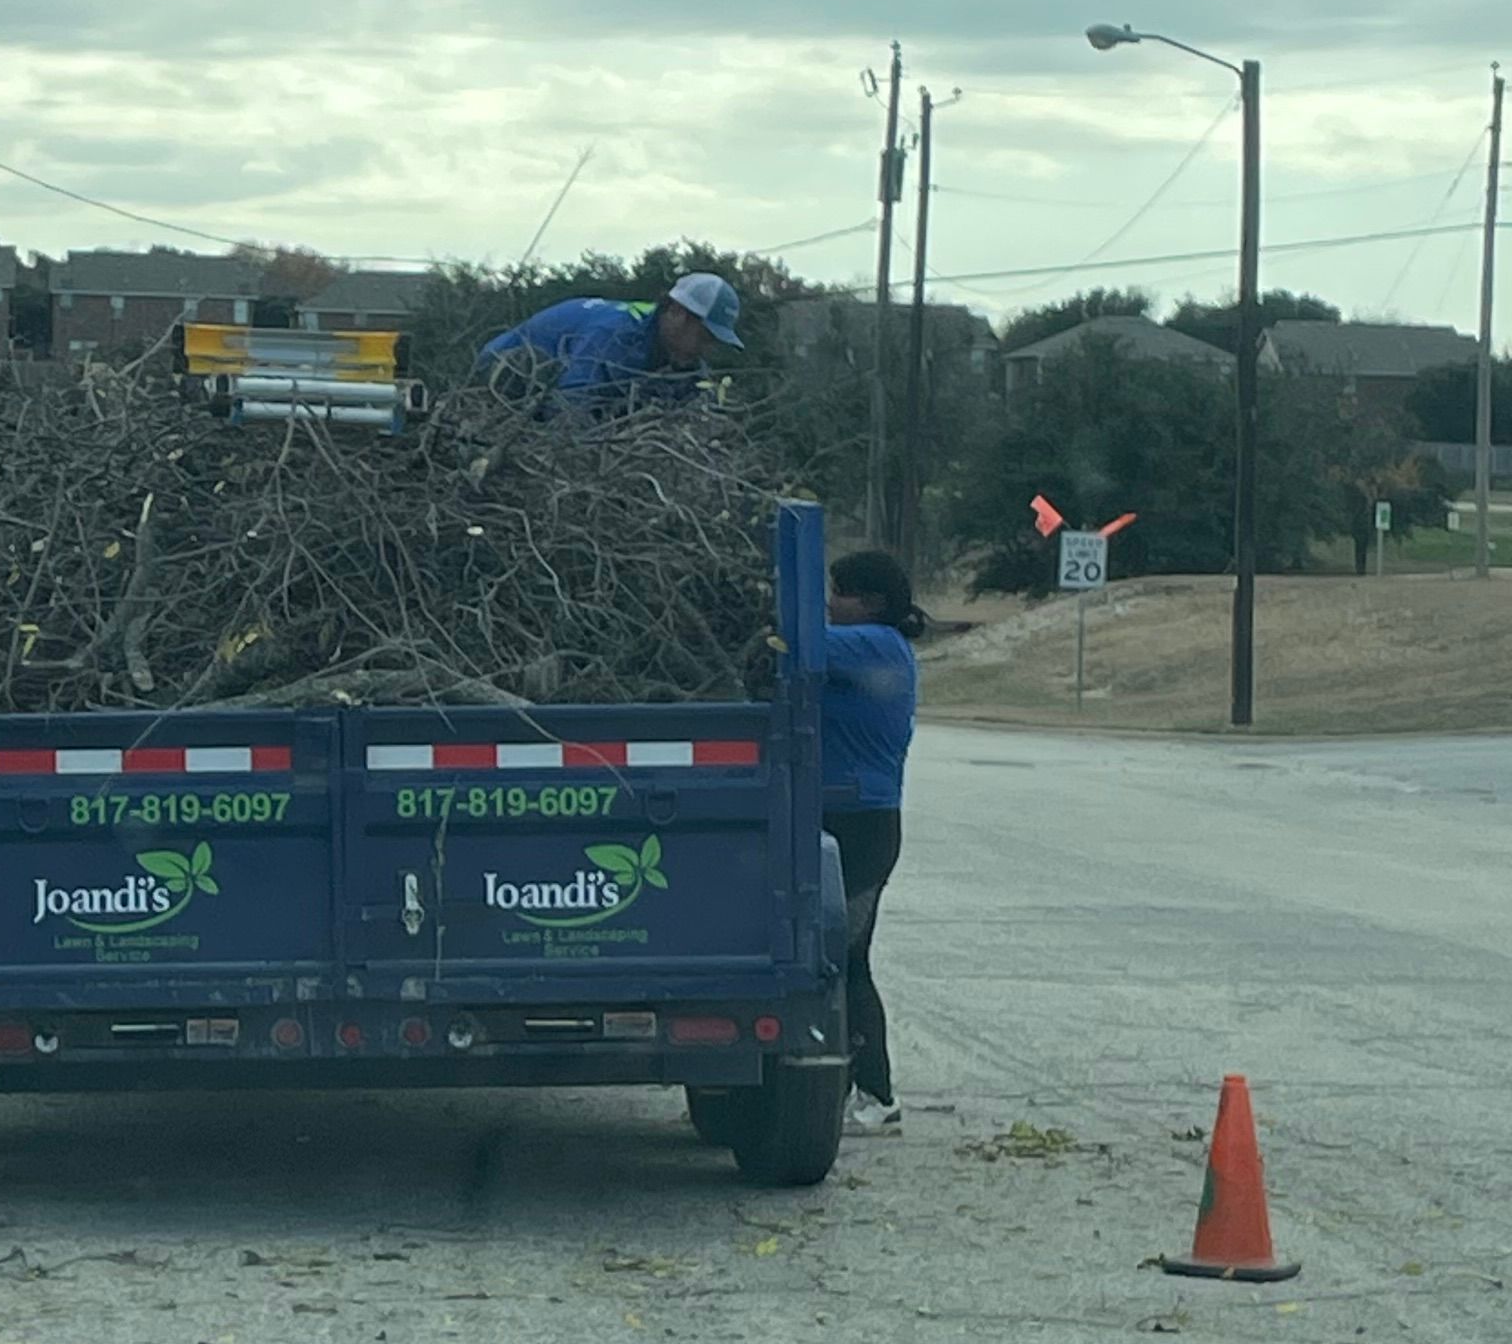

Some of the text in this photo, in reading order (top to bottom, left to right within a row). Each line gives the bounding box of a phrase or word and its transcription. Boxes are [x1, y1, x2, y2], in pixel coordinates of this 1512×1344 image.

[1064, 560, 1101, 582] 20
[70, 793, 291, 825] 817-819-6097
[396, 787, 618, 817] 817-819-6097
[33, 876, 171, 924] Joandi's
[53, 934, 92, 949] Lawn
[502, 929, 540, 944] Lawn
